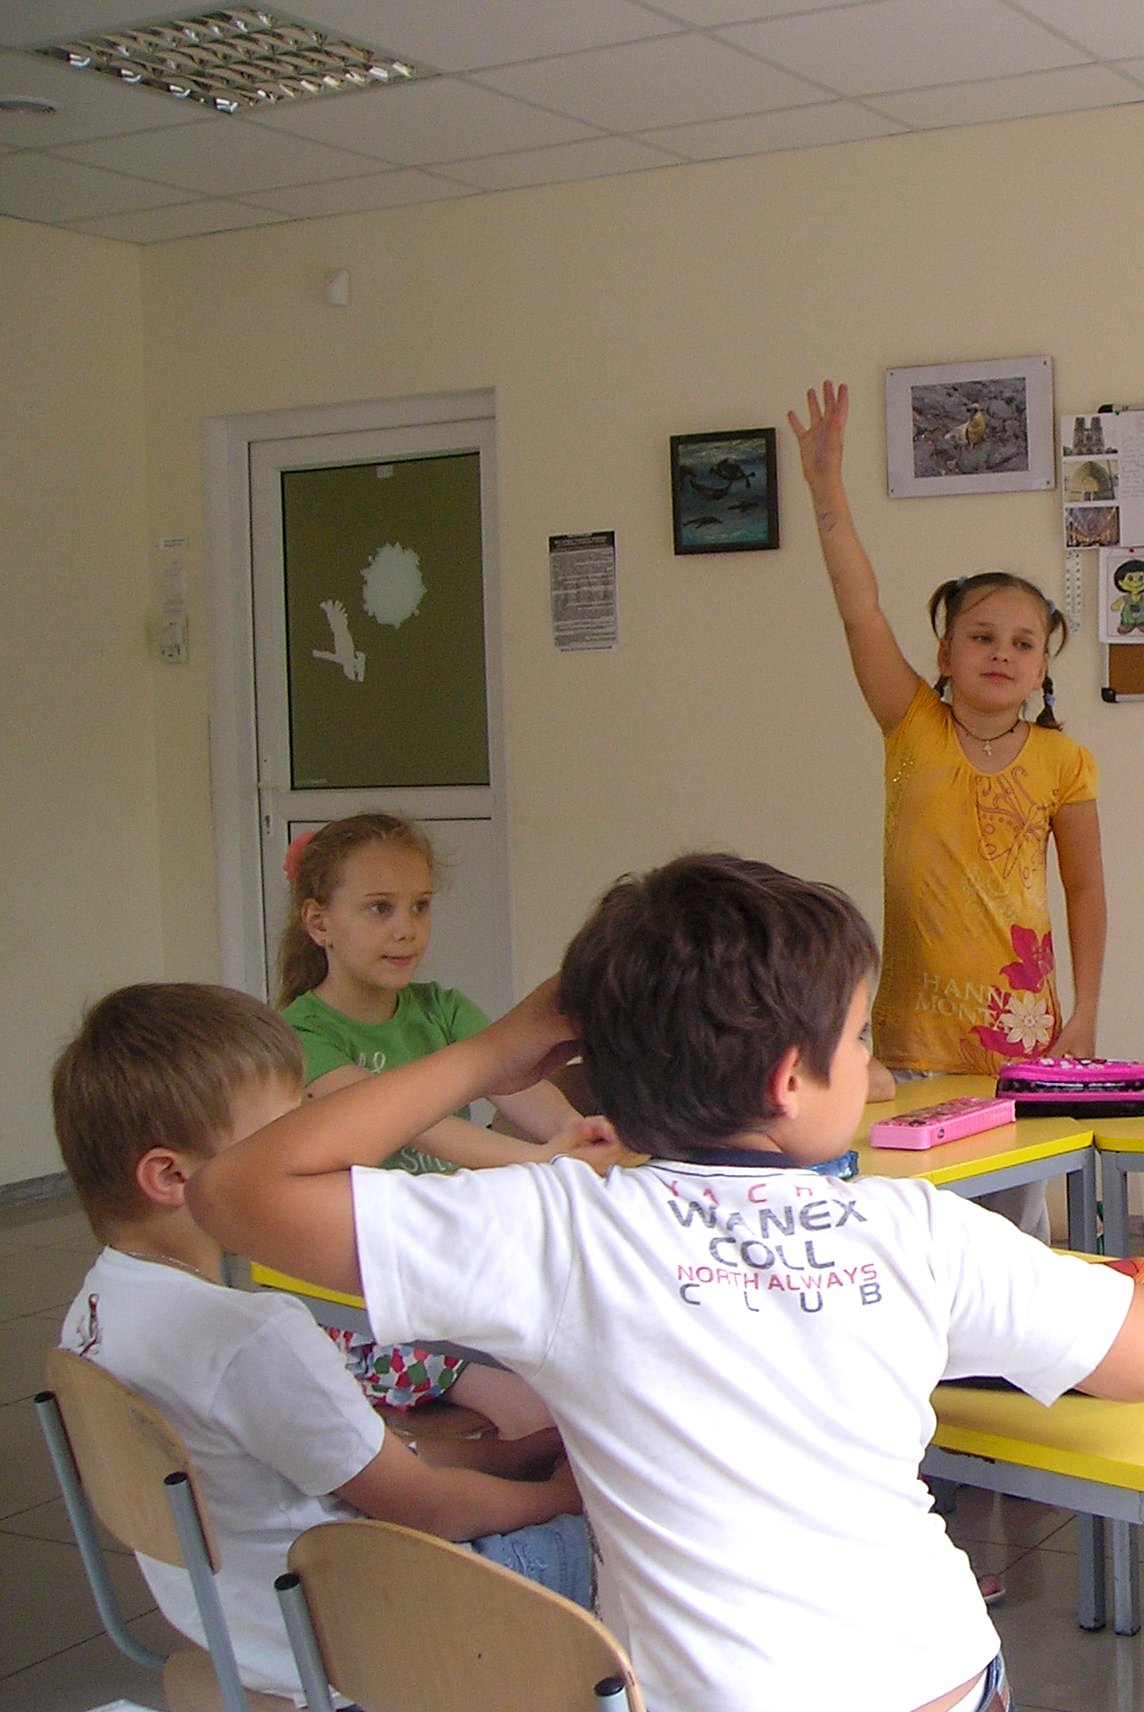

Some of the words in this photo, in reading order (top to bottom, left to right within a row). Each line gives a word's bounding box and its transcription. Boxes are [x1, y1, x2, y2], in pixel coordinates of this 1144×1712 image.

[667, 1199, 868, 1239] WANEX
[708, 1236, 836, 1271] COLL
[677, 1264, 759, 1291] NORTH
[767, 1263, 878, 1292] ALWAYS
